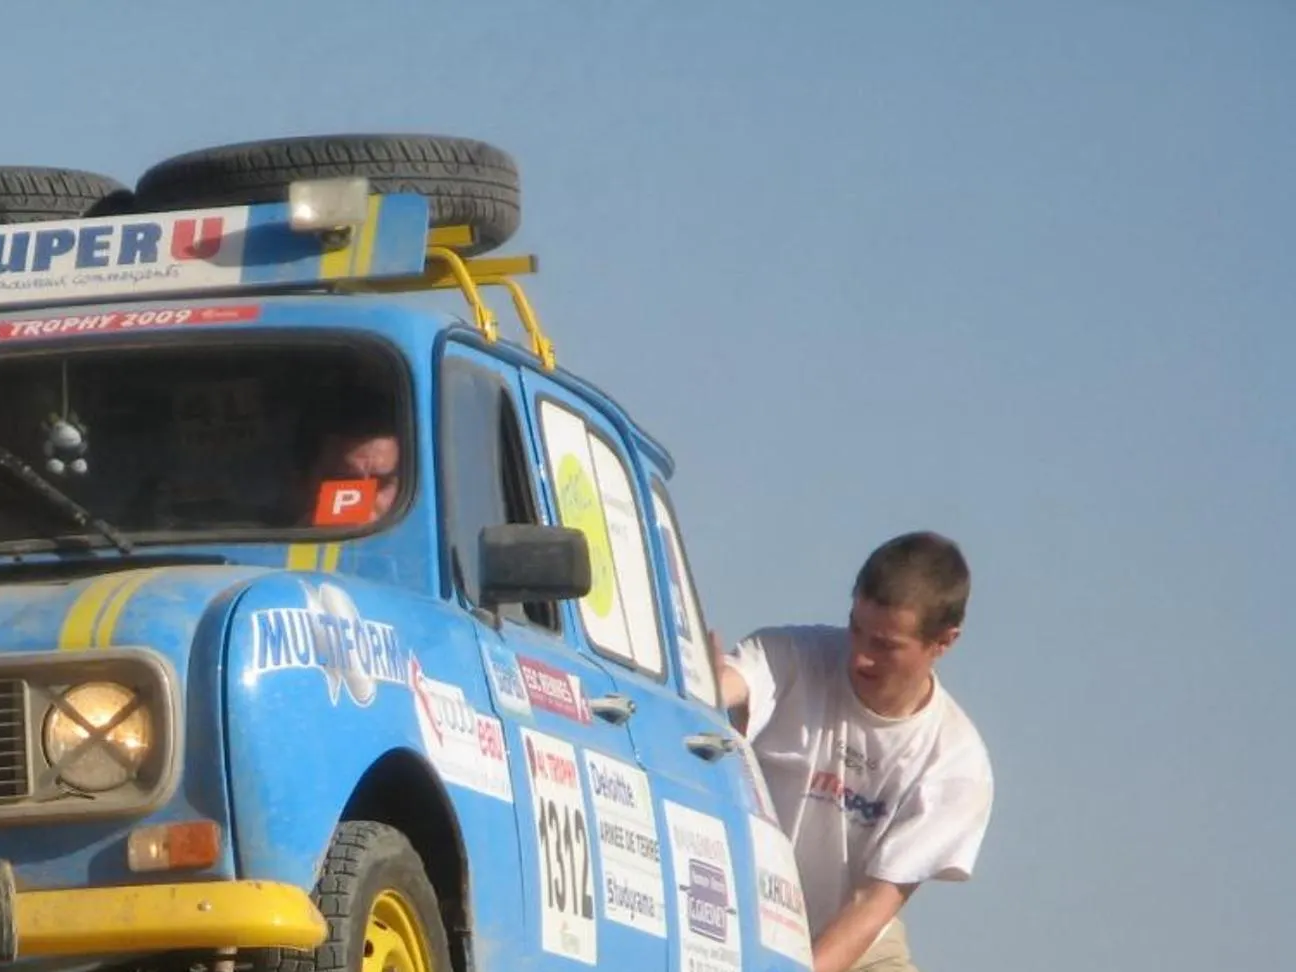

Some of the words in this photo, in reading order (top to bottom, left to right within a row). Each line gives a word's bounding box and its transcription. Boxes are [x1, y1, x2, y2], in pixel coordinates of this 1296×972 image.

[170, 217, 224, 260] U
[10, 314, 116, 336] TROPHY
[120, 309, 193, 328] 2009
[332, 489, 361, 515] P
[538, 795, 594, 920] 1312
